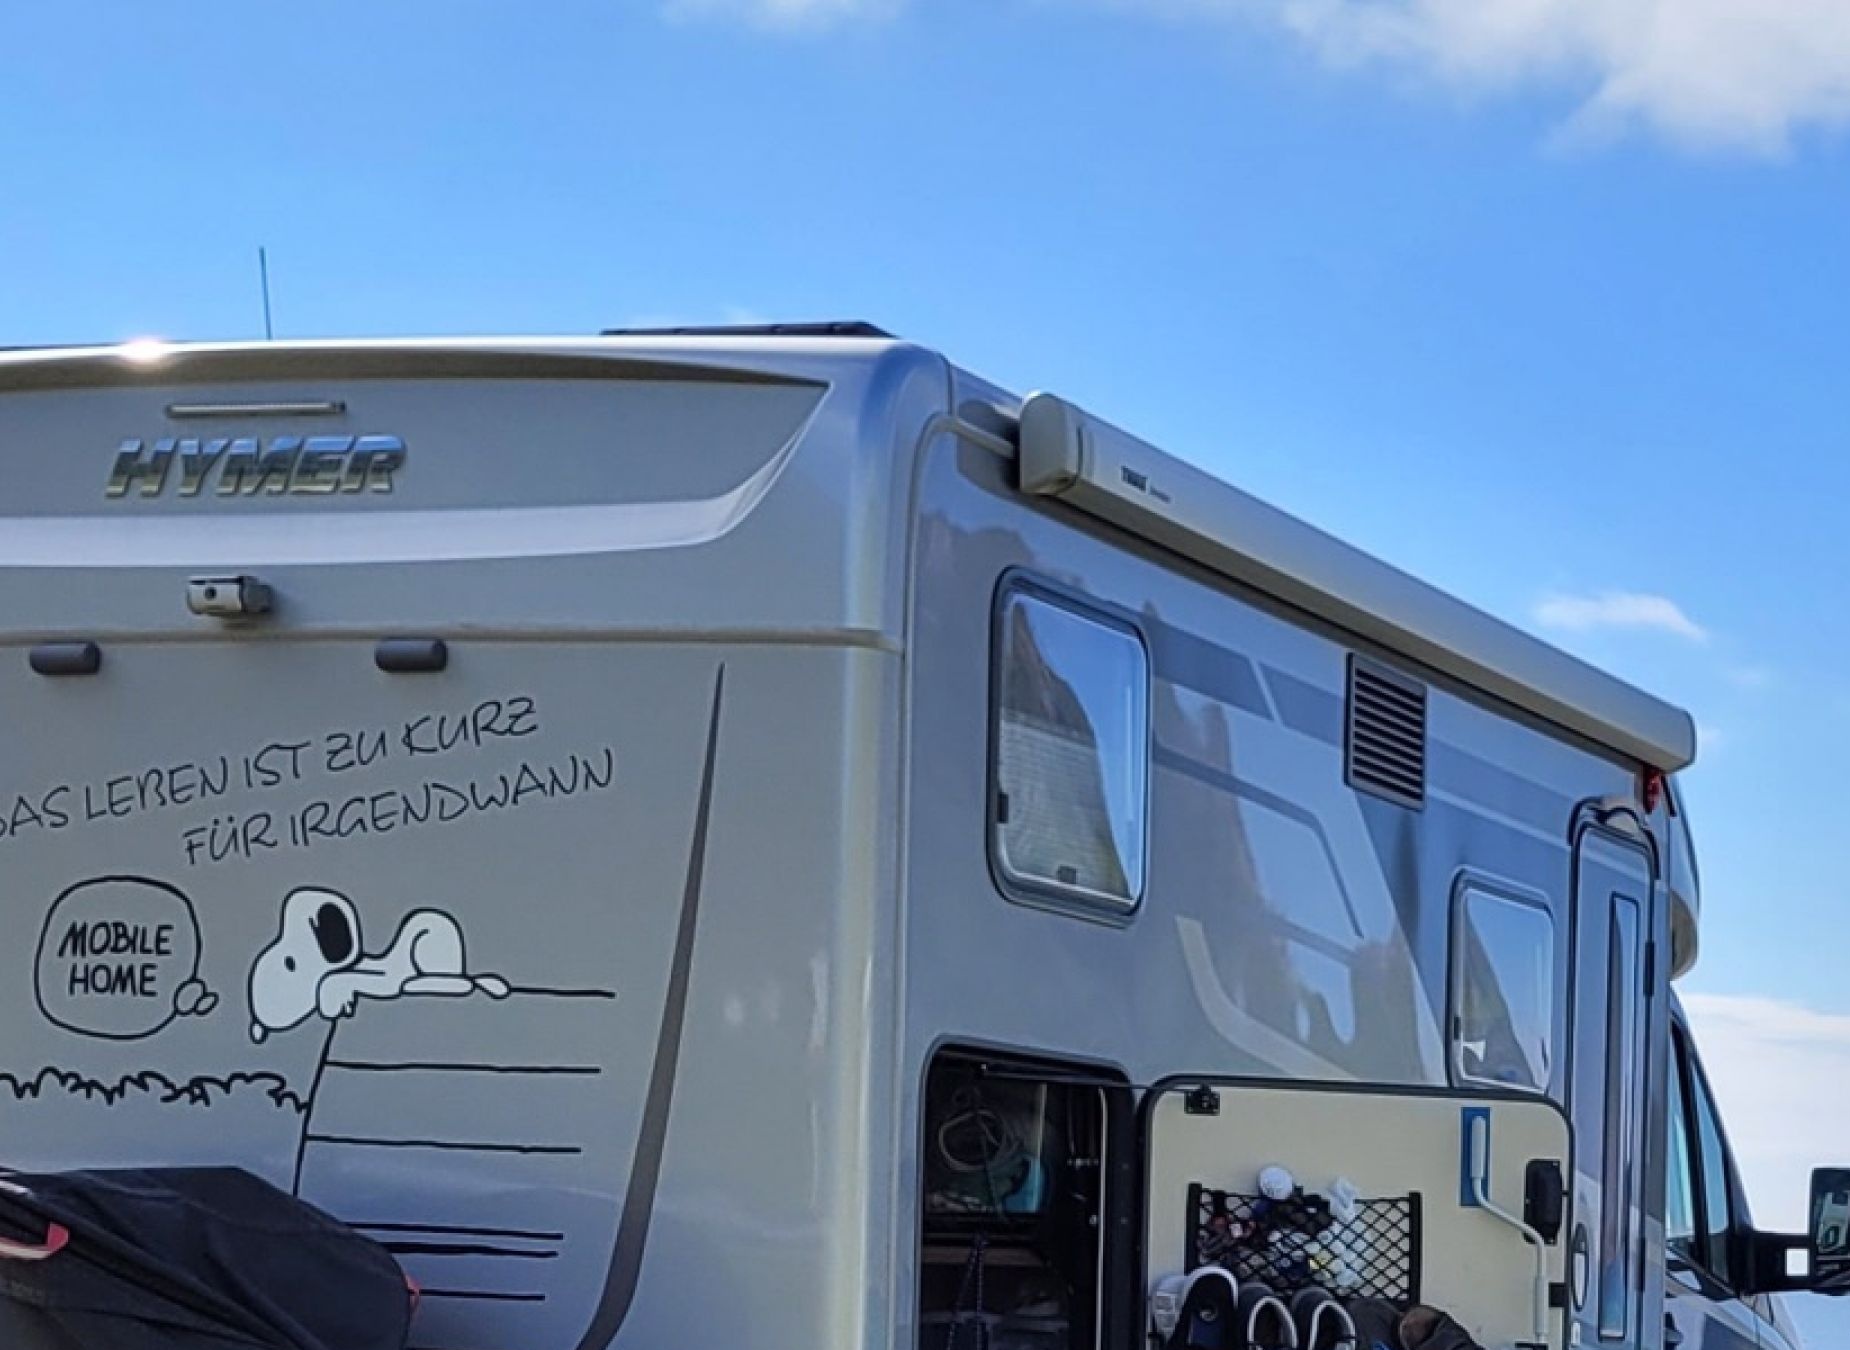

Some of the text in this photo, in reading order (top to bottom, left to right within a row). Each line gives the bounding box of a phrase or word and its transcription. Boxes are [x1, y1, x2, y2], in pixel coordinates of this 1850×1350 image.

[105, 435, 407, 498] HYMER
[85, 756, 230, 820] LEBEN
[242, 740, 312, 788] IST
[325, 730, 388, 773] ZU
[401, 696, 538, 756] KURZ
[182, 748, 614, 866] FÜR IRGENDWANN
[57, 920, 174, 958] MOBILE
[69, 962, 158, 997] HOME
